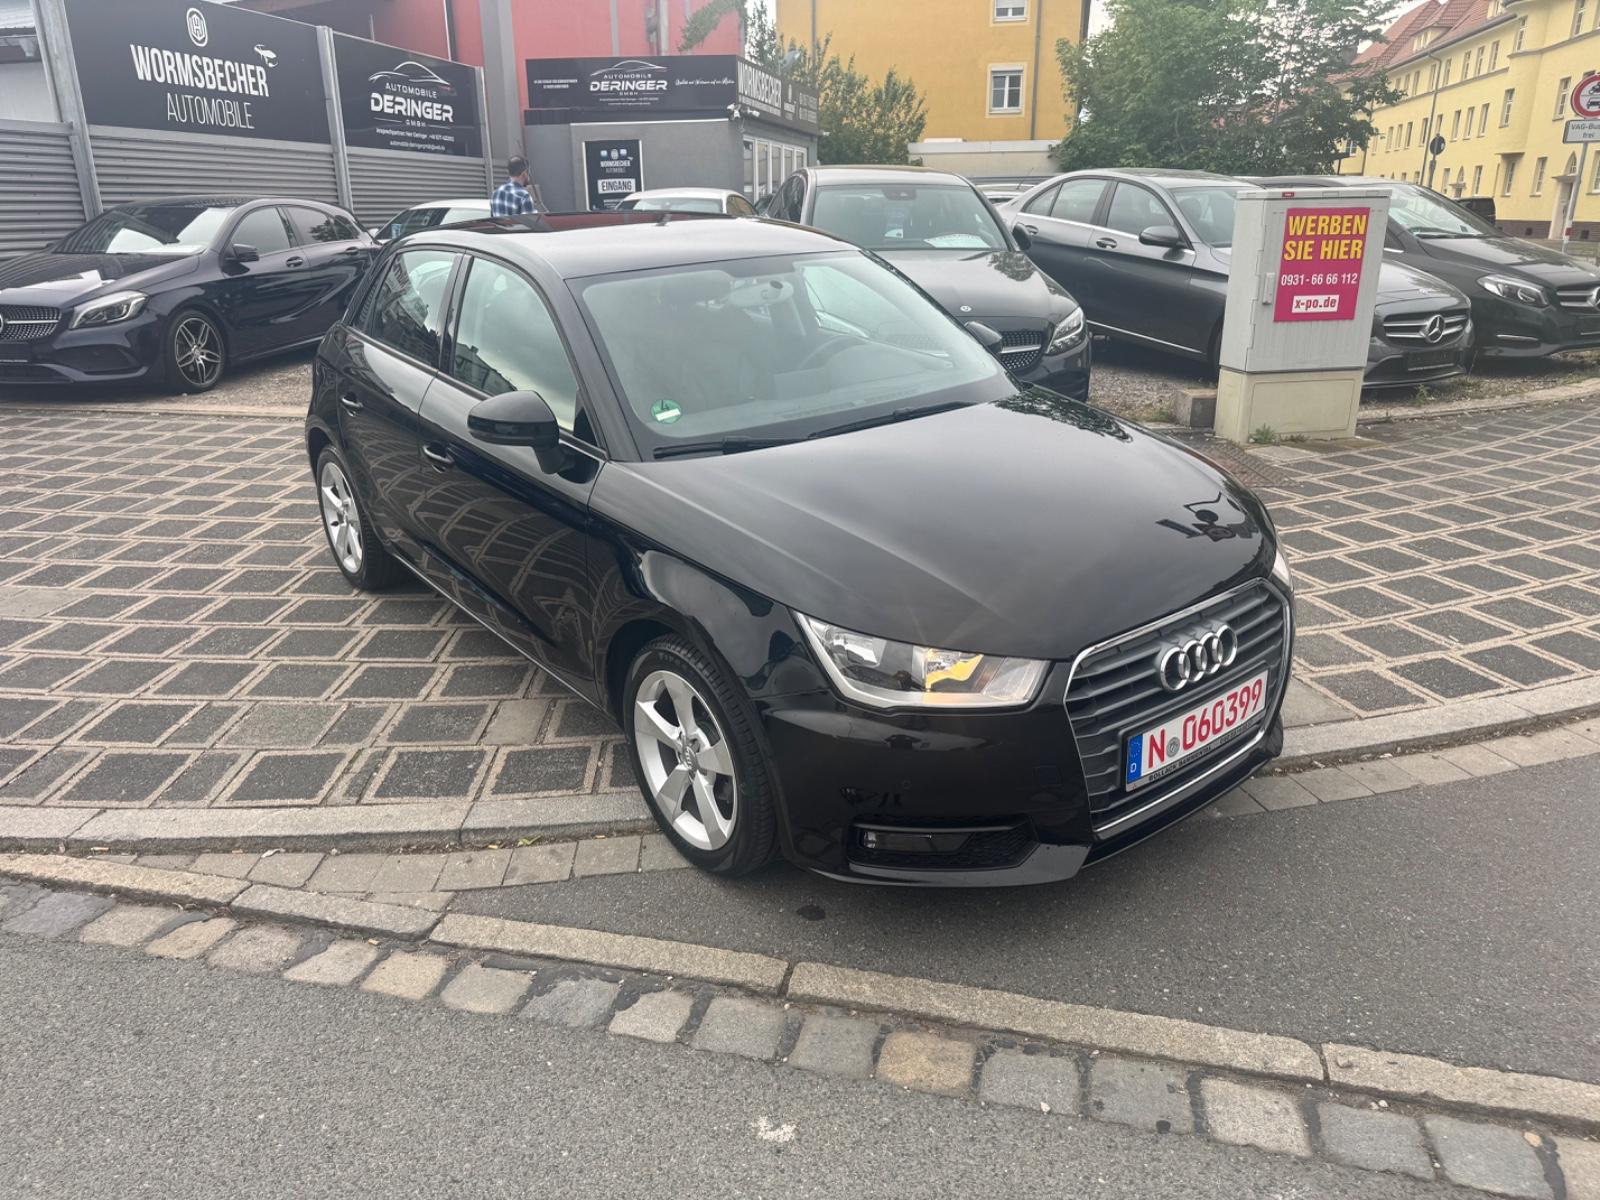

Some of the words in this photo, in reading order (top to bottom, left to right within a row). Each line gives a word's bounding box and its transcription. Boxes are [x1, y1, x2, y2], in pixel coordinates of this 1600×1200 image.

[129, 44, 269, 97] WORMSBECHER
[385, 82, 438, 99] AUTOMOBILE
[590, 80, 668, 91] DERINGER
[167, 93, 255, 129] AUTOMOBILE
[370, 92, 454, 122] DERINGER
[601, 180, 632, 192] EINGANG
[1288, 215, 1367, 235] WERBEN
[1283, 240, 1315, 261] SIE
[1320, 239, 1363, 260] HIER
[1326, 273, 1338, 285] 66
[1341, 273, 1358, 285] 112
[1294, 296, 1337, 311] x-po.de
[1148, 728, 1165, 769] N
[1182, 678, 1263, 751] 060399
[1130, 762, 1137, 773] D
